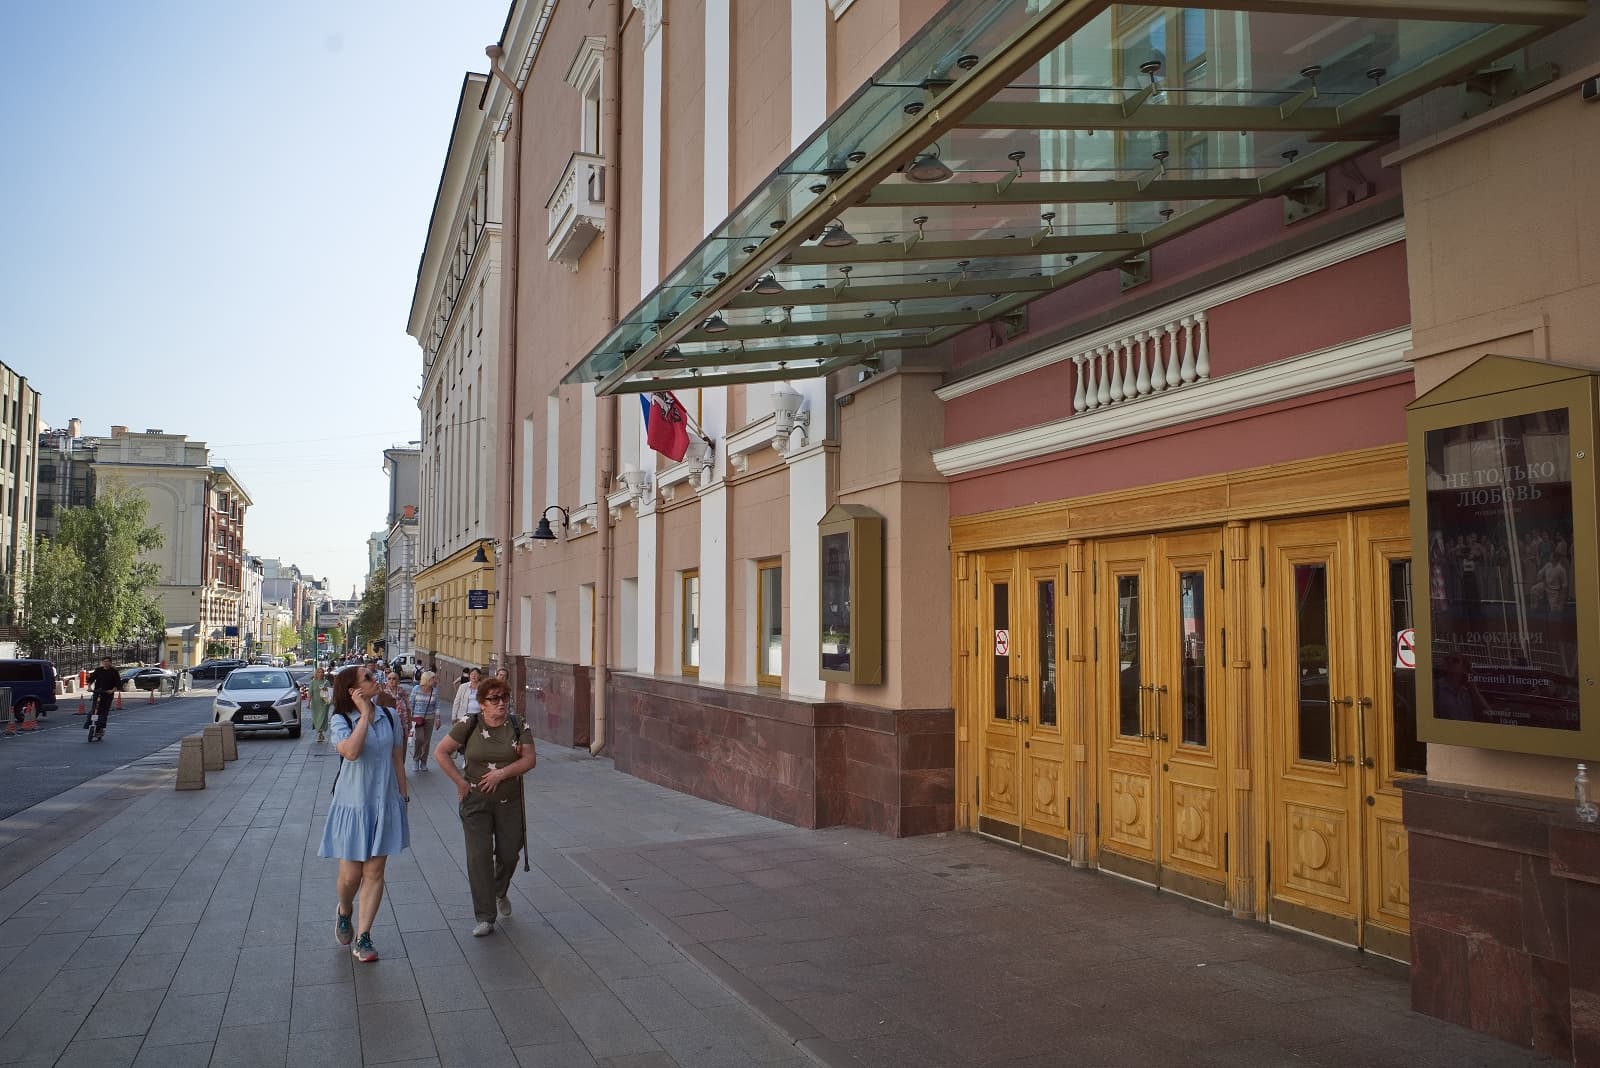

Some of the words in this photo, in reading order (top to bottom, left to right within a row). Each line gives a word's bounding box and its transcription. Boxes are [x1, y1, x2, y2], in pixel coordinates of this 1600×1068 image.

[1446, 471, 1470, 489] НЕ
[1473, 461, 1555, 485] ТОЛЬКО
[1456, 484, 1542, 508] ЛЮБОВЬ
[1466, 631, 1481, 643] 20
[1467, 673, 1506, 684] Евгений
[1508, 674, 1549, 687] Писарев
